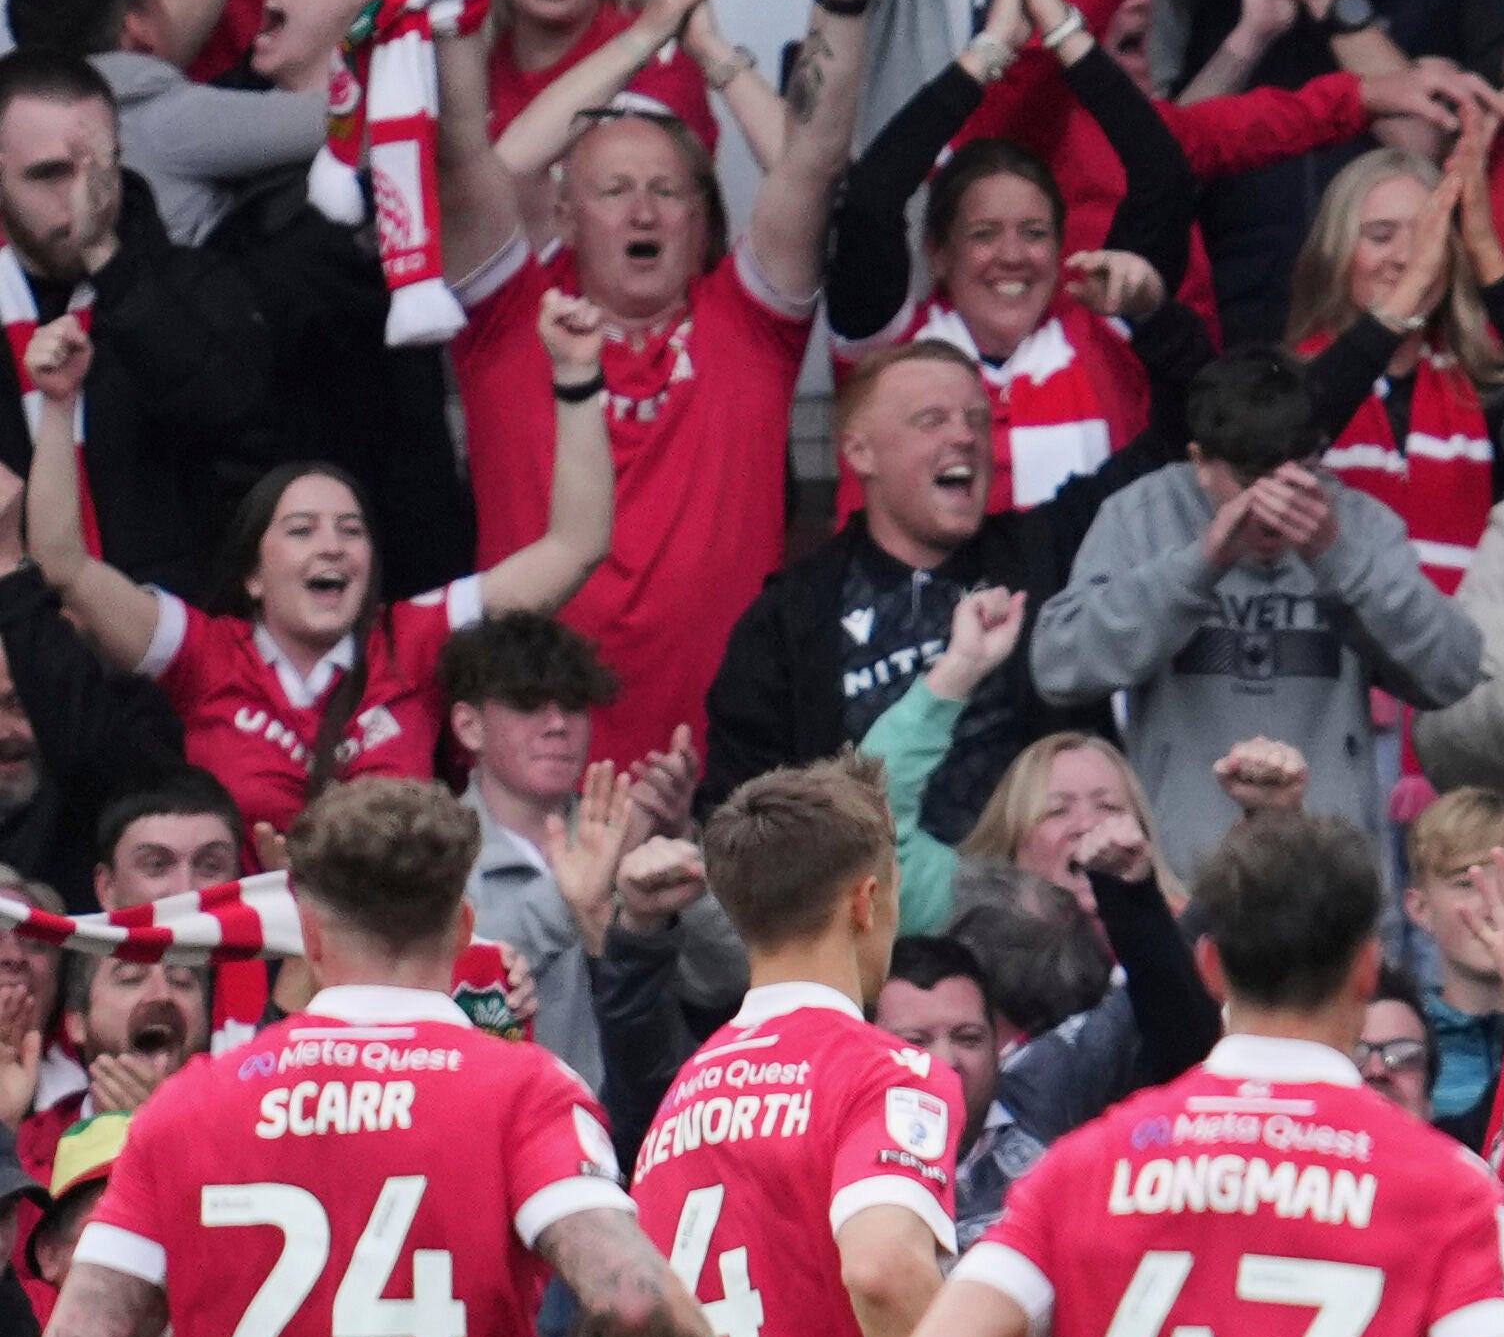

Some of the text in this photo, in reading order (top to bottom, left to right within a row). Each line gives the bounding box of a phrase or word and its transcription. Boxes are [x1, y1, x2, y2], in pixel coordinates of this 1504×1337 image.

[234, 706, 361, 772] UNID
[277, 1039, 463, 1076] Meta Quest
[726, 1059, 812, 1089] Quest
[255, 1080, 416, 1139] SCARR
[1172, 1111, 1372, 1163] Meta Quest
[1109, 1155, 1378, 1229] LONGMAN
